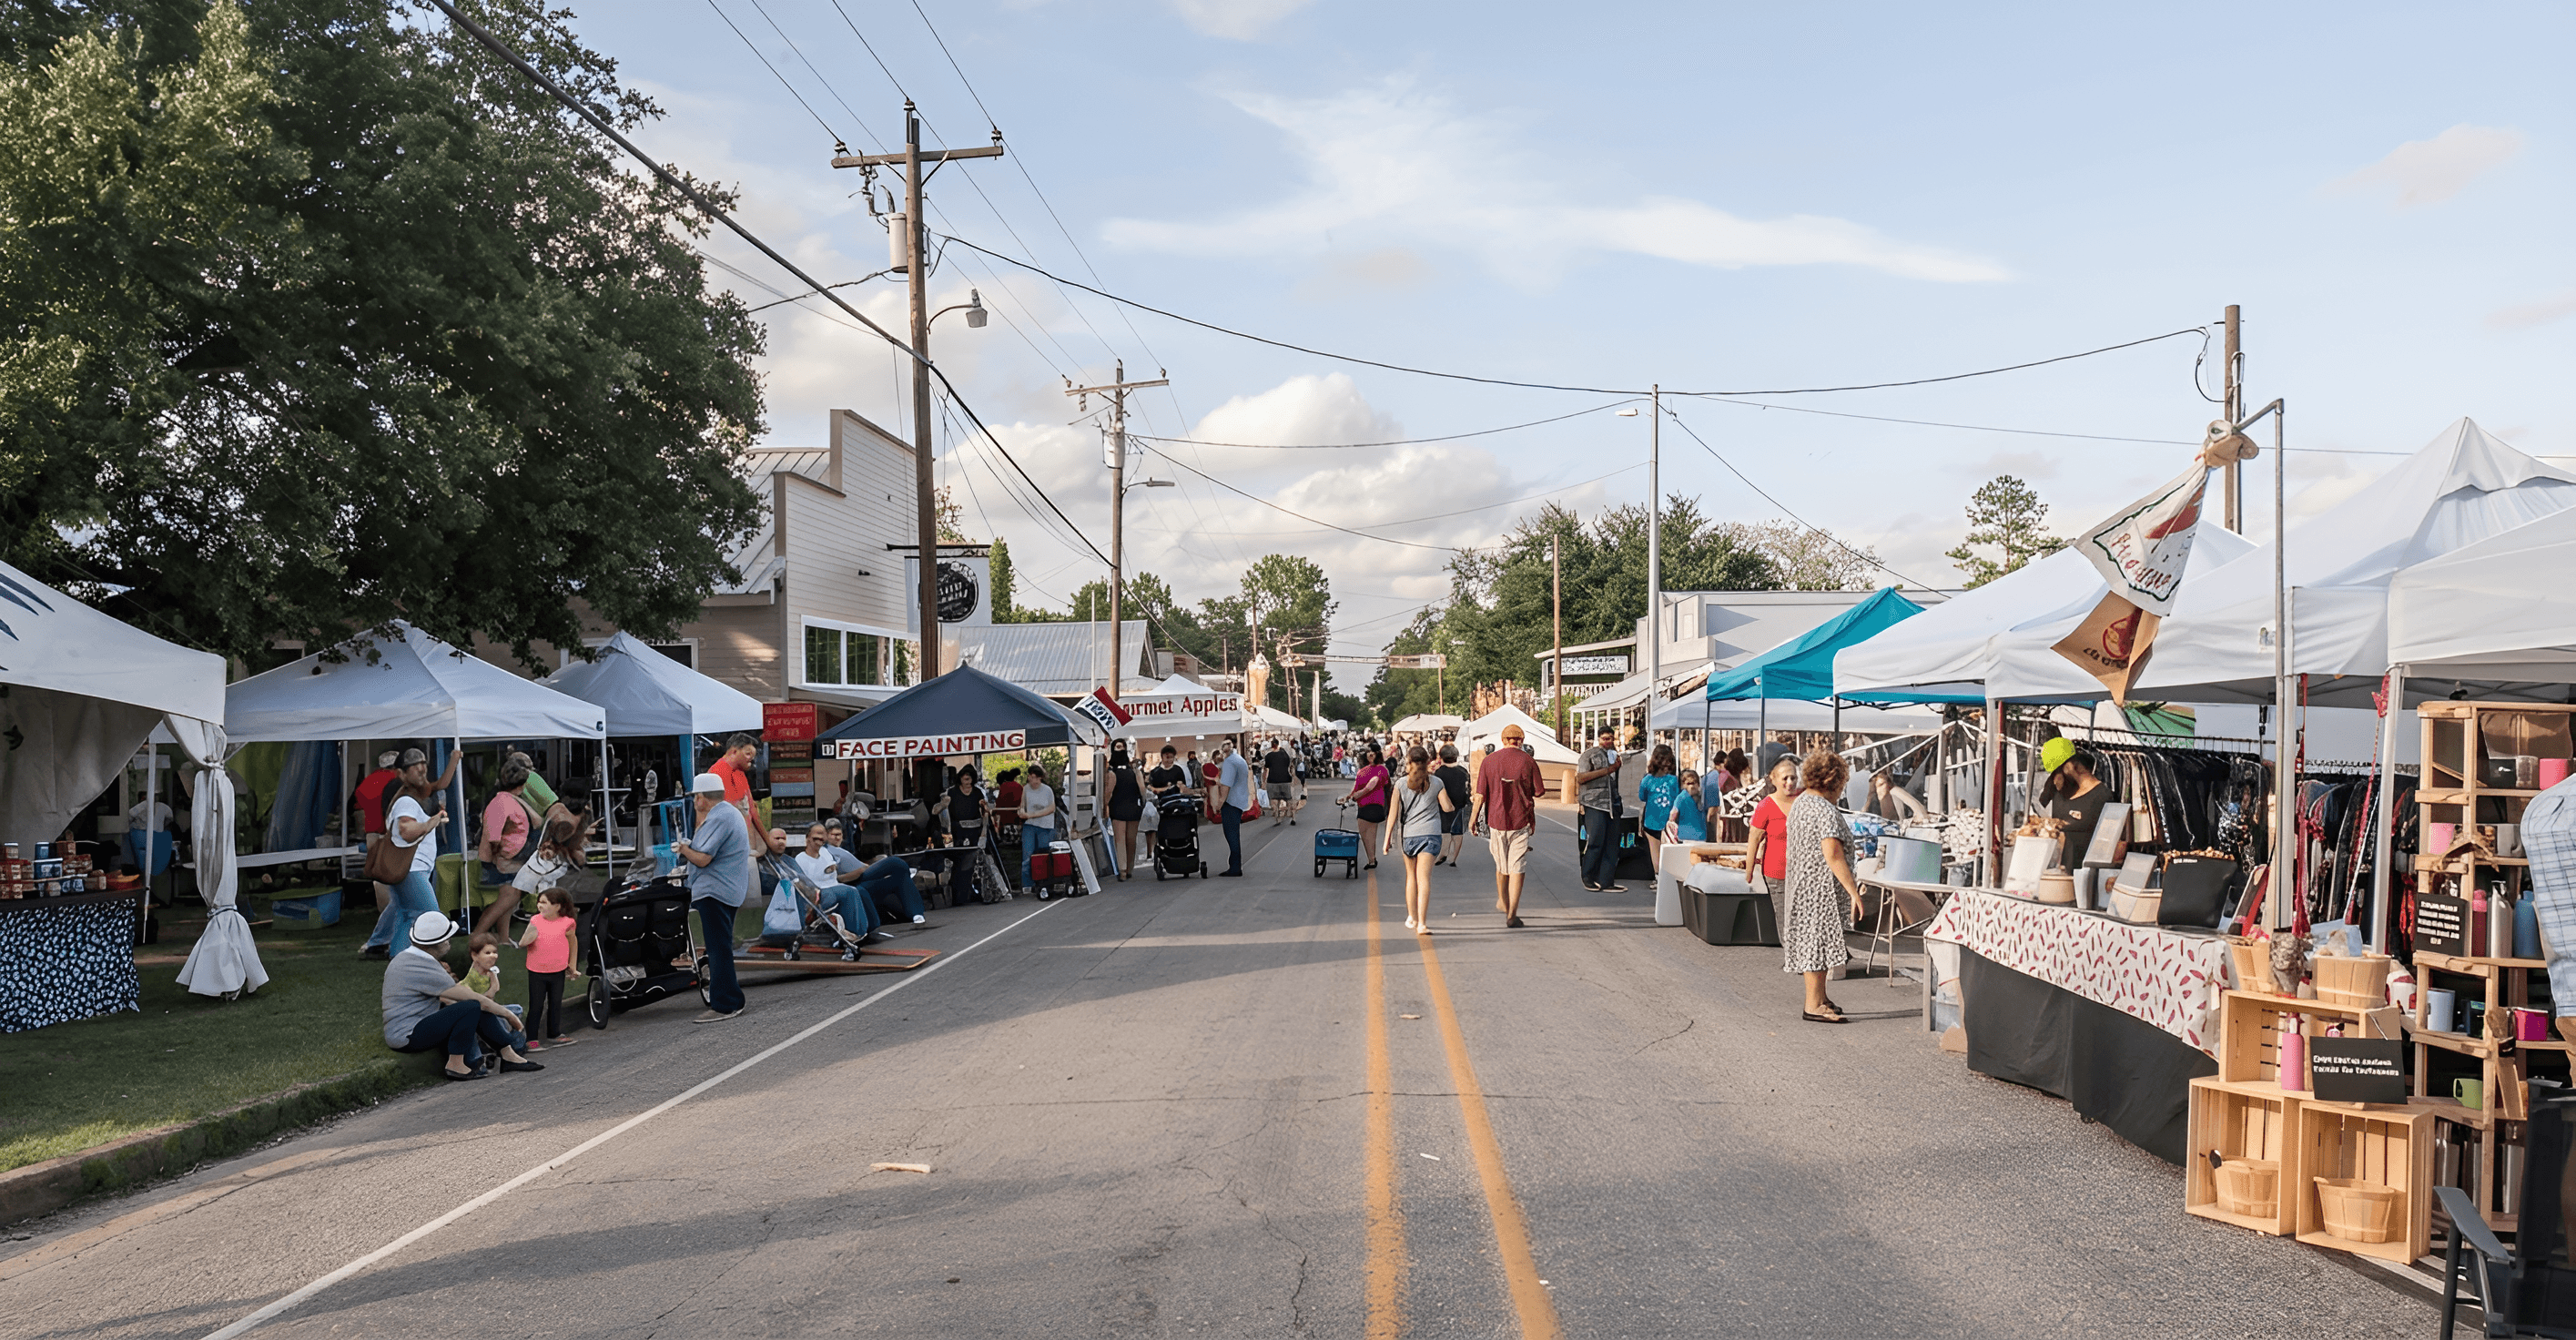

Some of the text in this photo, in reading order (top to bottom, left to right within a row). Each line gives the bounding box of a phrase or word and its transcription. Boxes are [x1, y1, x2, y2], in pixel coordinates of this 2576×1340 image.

[1181, 694, 1237, 716] Apples
[839, 740, 898, 757] FACE
[905, 733, 1024, 755] PAINTING
